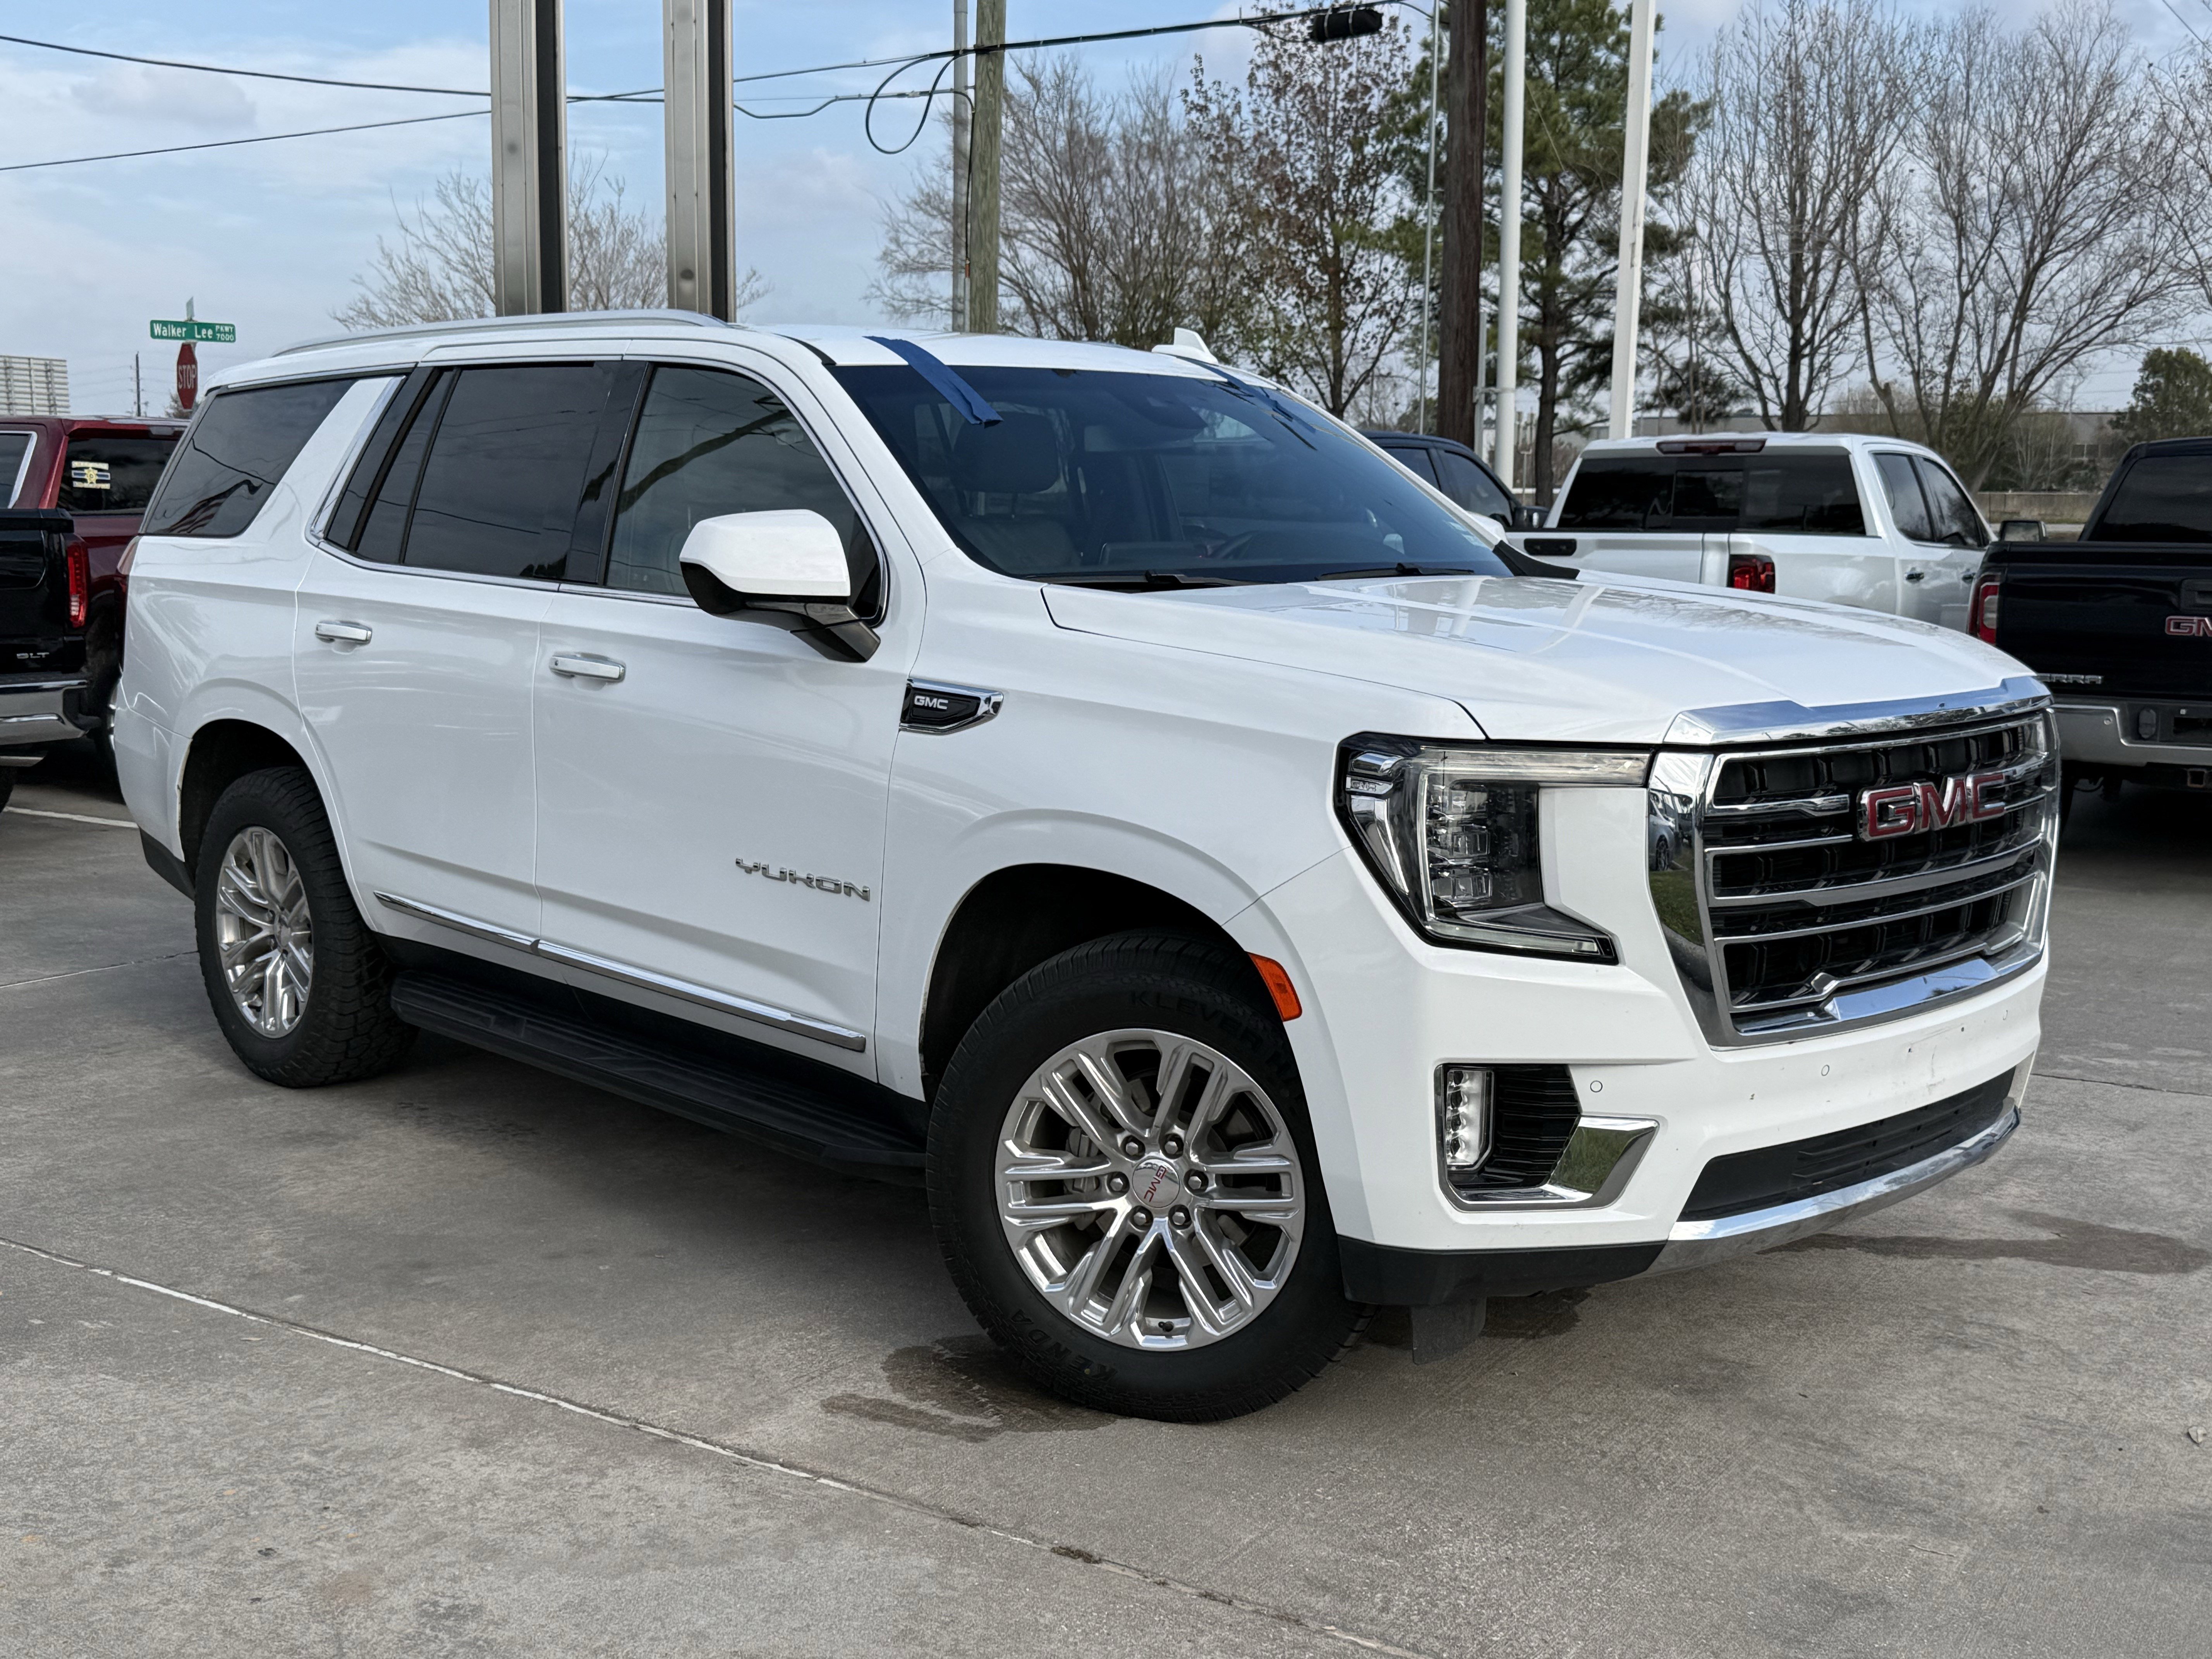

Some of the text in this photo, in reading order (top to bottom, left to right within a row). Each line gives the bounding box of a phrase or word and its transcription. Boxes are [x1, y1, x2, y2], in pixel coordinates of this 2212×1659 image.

[153, 323, 213, 338] Walker Lee
[178, 364, 197, 389] STOP
[2165, 615, 2212, 637] GM
[914, 696, 948, 709] GMC
[1857, 774, 2007, 842] GMC
[736, 858, 870, 902] YUKON
[1144, 1165, 1168, 1202] GMC
[1011, 1309, 1118, 1382] KENDA
